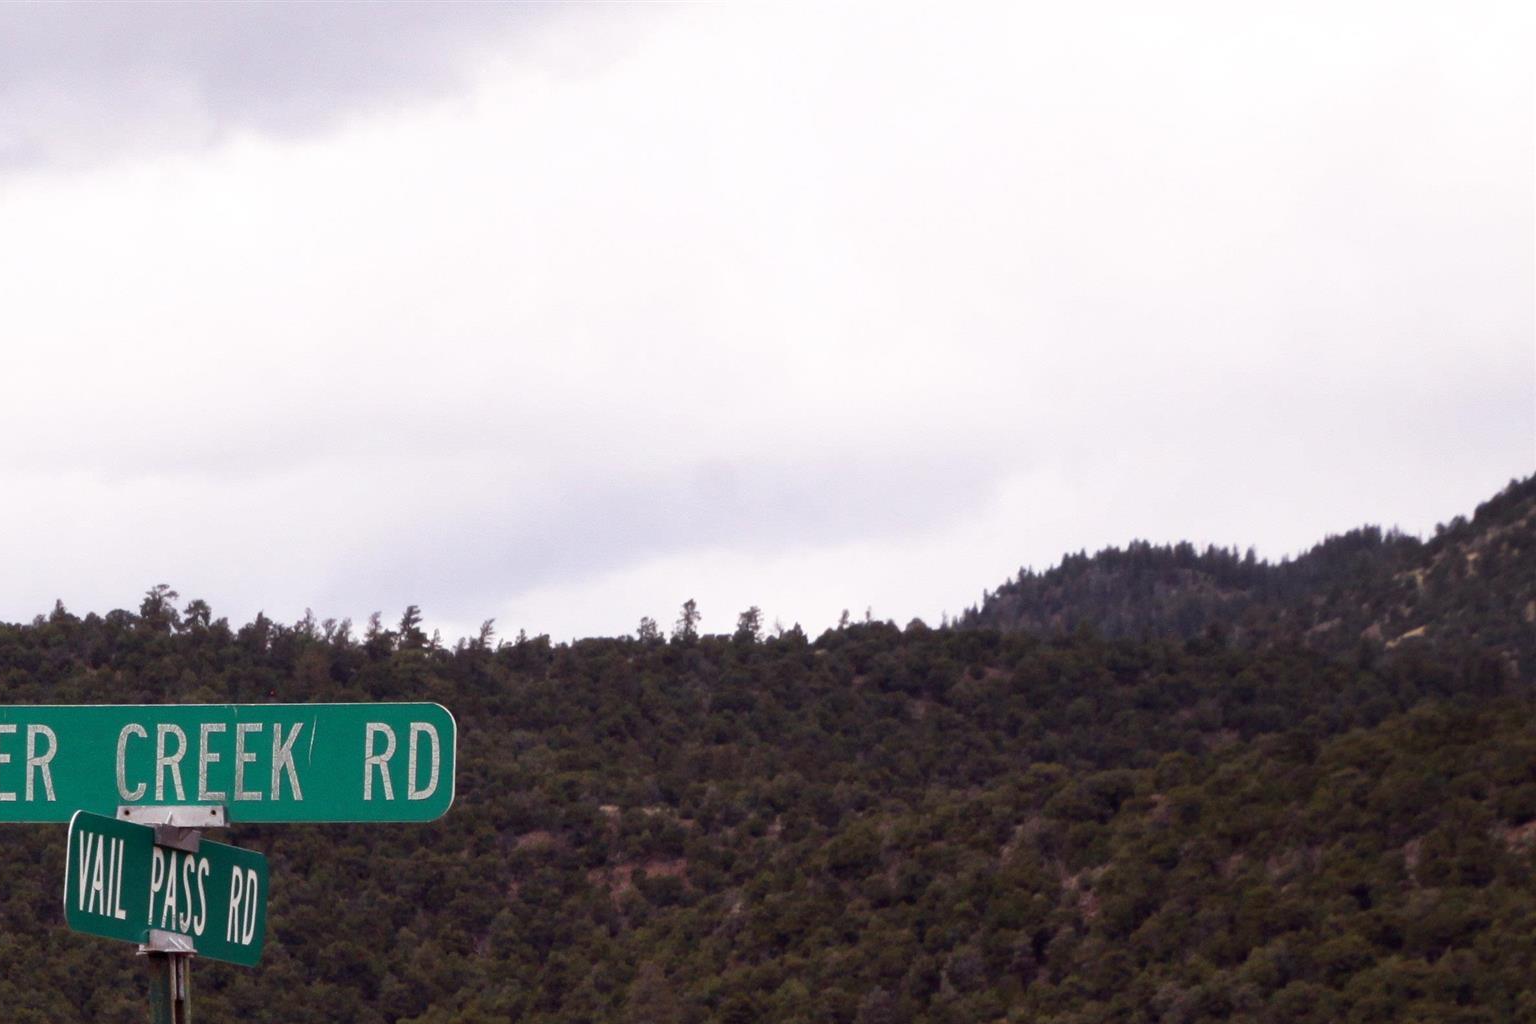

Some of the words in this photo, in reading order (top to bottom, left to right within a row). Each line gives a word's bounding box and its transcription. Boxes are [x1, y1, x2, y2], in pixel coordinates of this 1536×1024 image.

[115, 722, 304, 801] CREEK
[364, 721, 441, 800] RD
[79, 830, 126, 920] VAIL
[148, 846, 209, 936] PASS
[226, 865, 258, 946] RD
